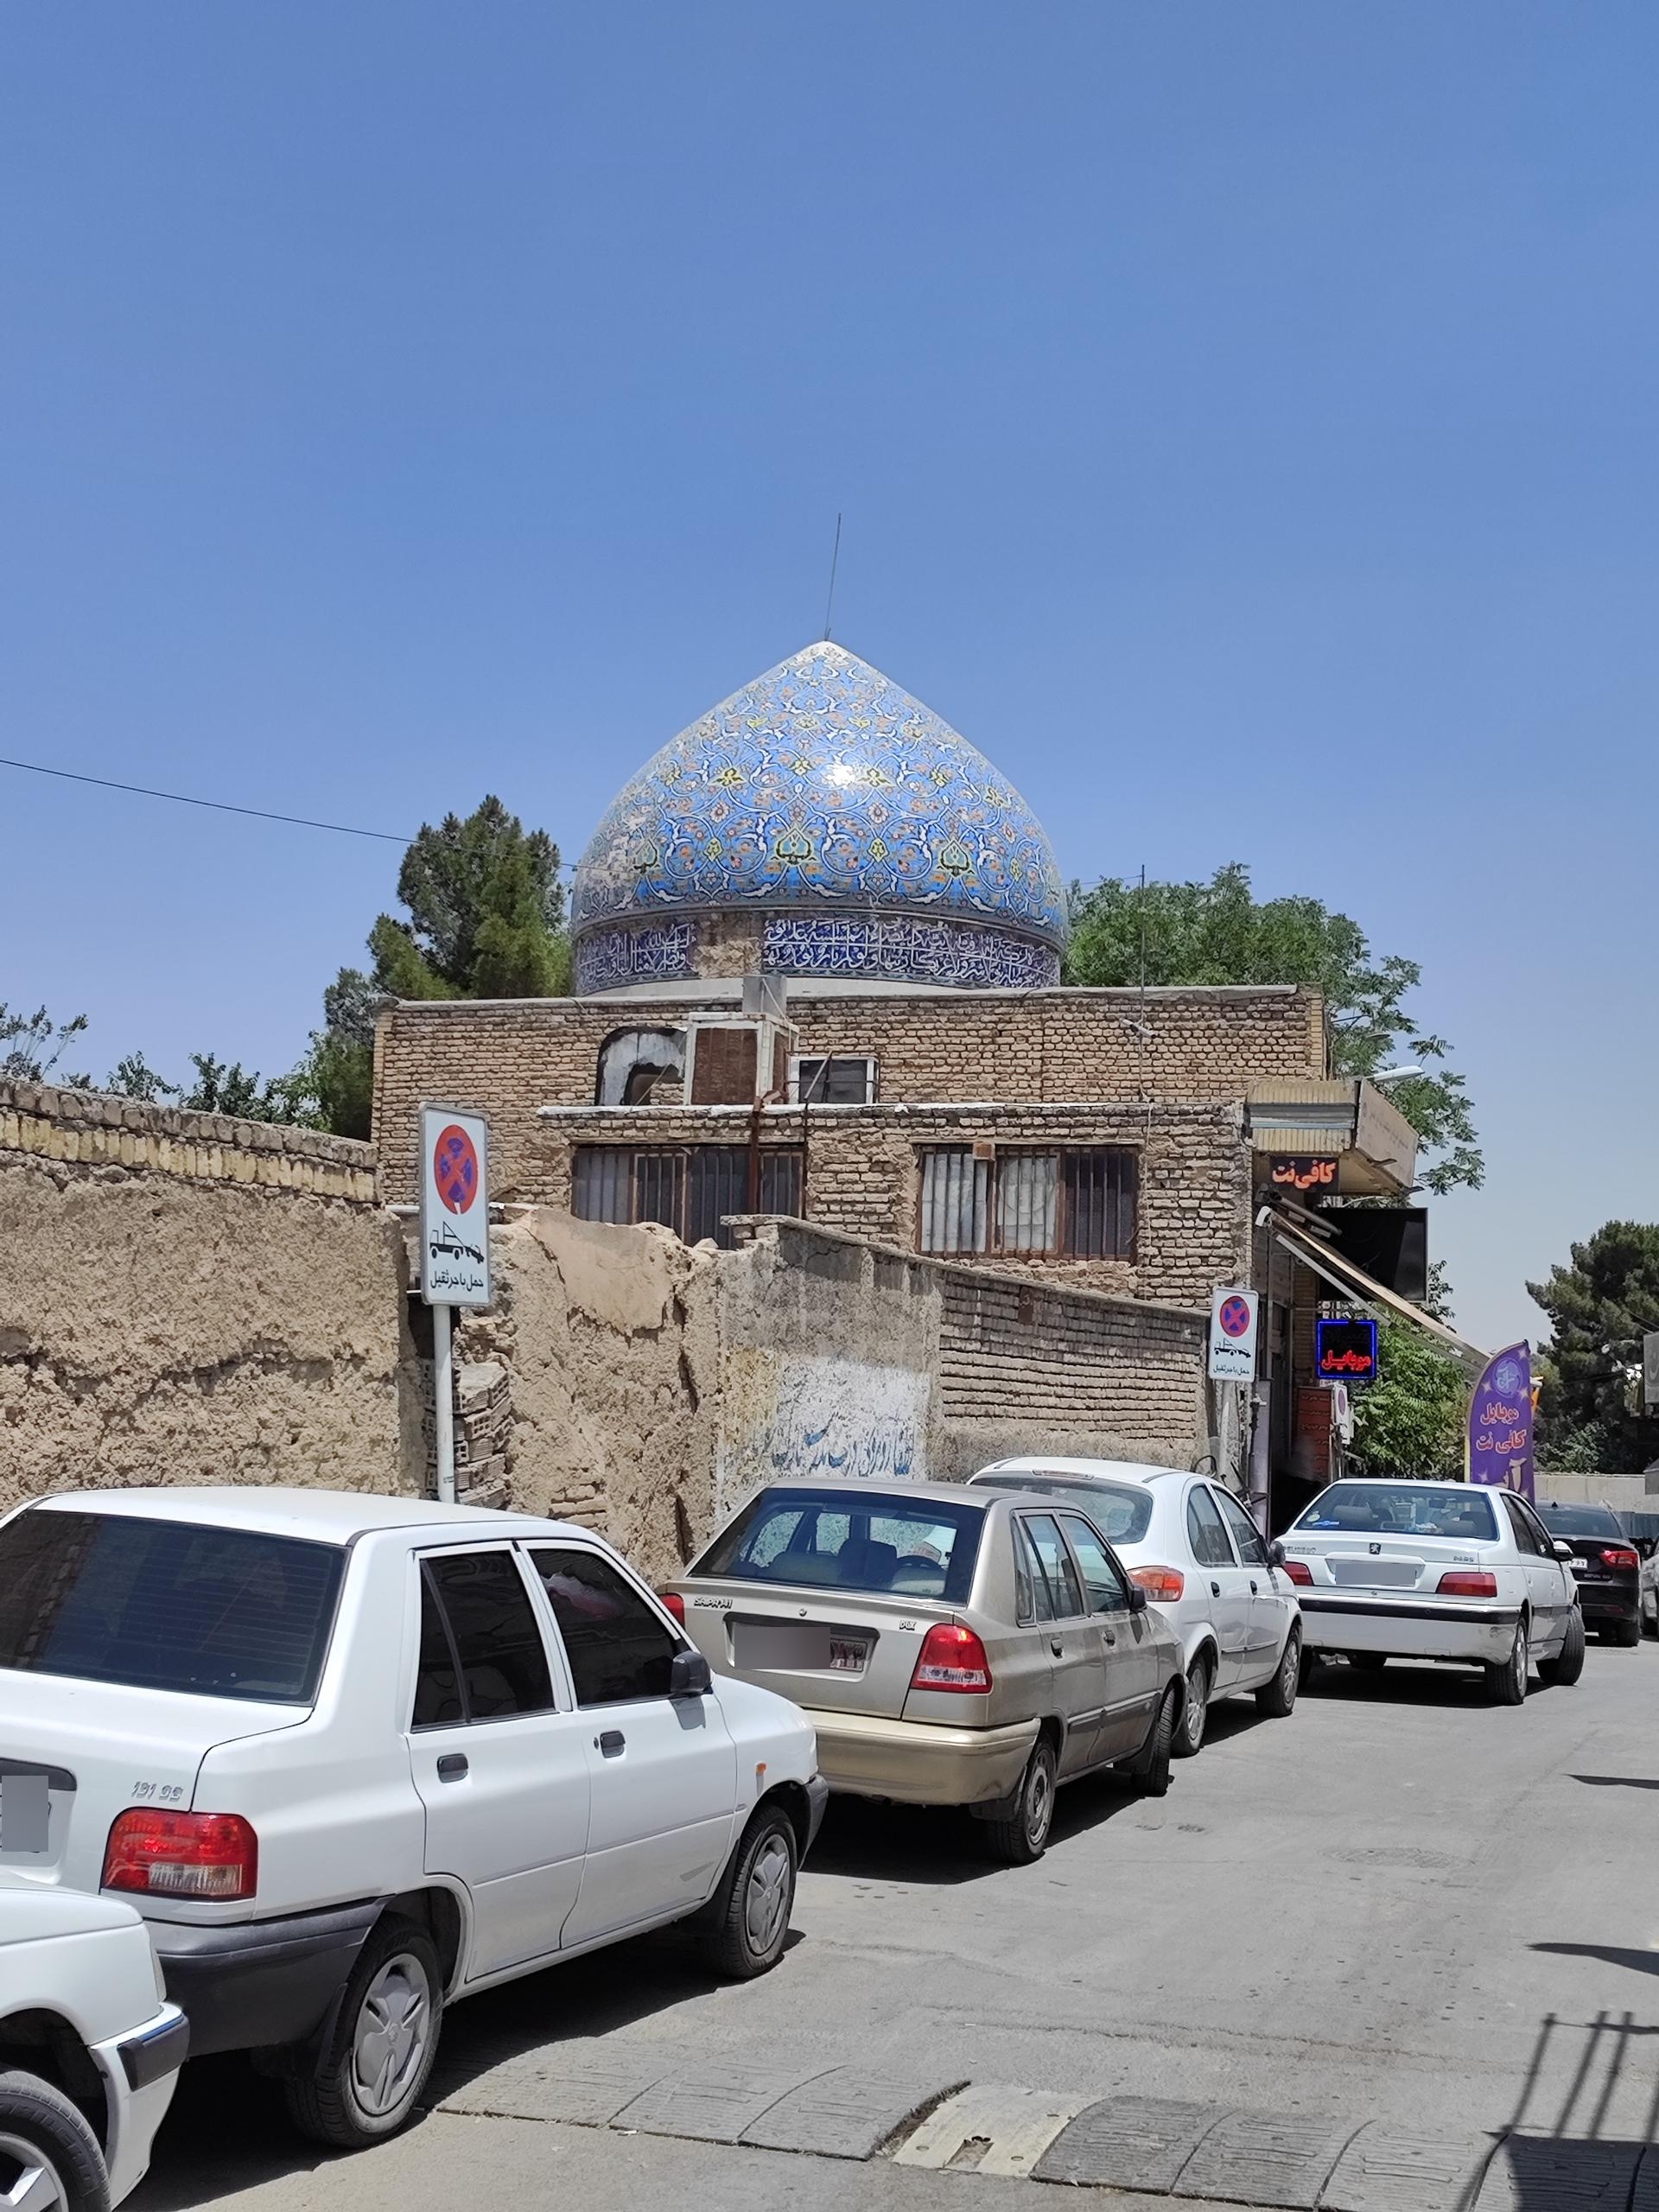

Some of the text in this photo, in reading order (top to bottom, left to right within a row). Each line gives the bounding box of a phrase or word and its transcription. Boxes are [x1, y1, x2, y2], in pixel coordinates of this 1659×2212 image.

[1272, 1160, 1336, 1189] کافی نت
[430, 1269, 484, 1292] حمل با جرثقیل
[1321, 1350, 1371, 1370] موبایل
[1480, 1402, 1519, 1425] موبایل
[1476, 1429, 1527, 1453] کافی نت
